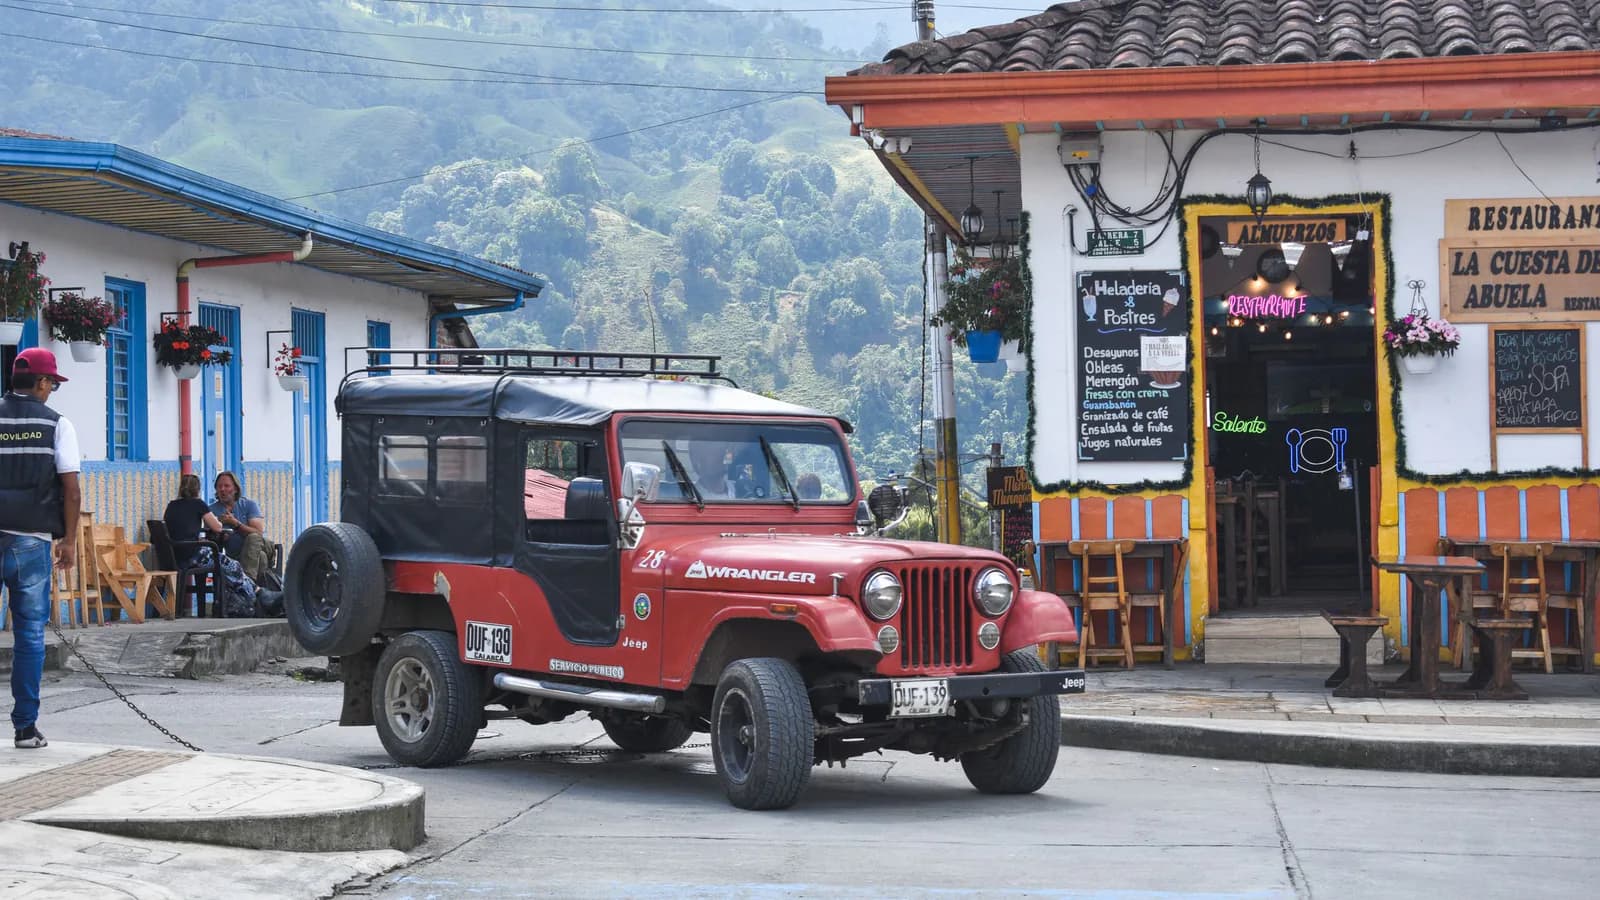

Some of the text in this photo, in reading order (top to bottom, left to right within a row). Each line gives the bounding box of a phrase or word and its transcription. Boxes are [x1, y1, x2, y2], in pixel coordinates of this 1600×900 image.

[1133, 230, 1139, 239] 7
[1238, 222, 1337, 244] ALMUERZOS
[1095, 239, 1121, 248] ALLE
[1133, 238, 1140, 247] 5
[1452, 251, 1480, 276] LA
[1490, 250, 1571, 275] CUESTA
[1124, 296, 1136, 307] &
[1463, 283, 1548, 309] ABUELA
[1228, 294, 1309, 319] RESTAURANTE
[1104, 308, 1156, 325] Postres
[1084, 346, 1139, 359] Desayunos
[1085, 360, 1124, 374] Obleas
[1086, 374, 1139, 389] Merengón
[1116, 389, 1135, 399] con
[1137, 389, 1169, 398] crema
[1082, 406, 1168, 421] Granizado de café
[1081, 421, 1173, 435] Ensalada de frutas
[1212, 411, 1267, 434] Salento
[1081, 435, 1162, 451] Jugos naturales
[638, 549, 666, 569] 28
[705, 565, 816, 584] WRANGLER
[622, 637, 648, 651] Jeep
[1062, 677, 1084, 689] Jeep
